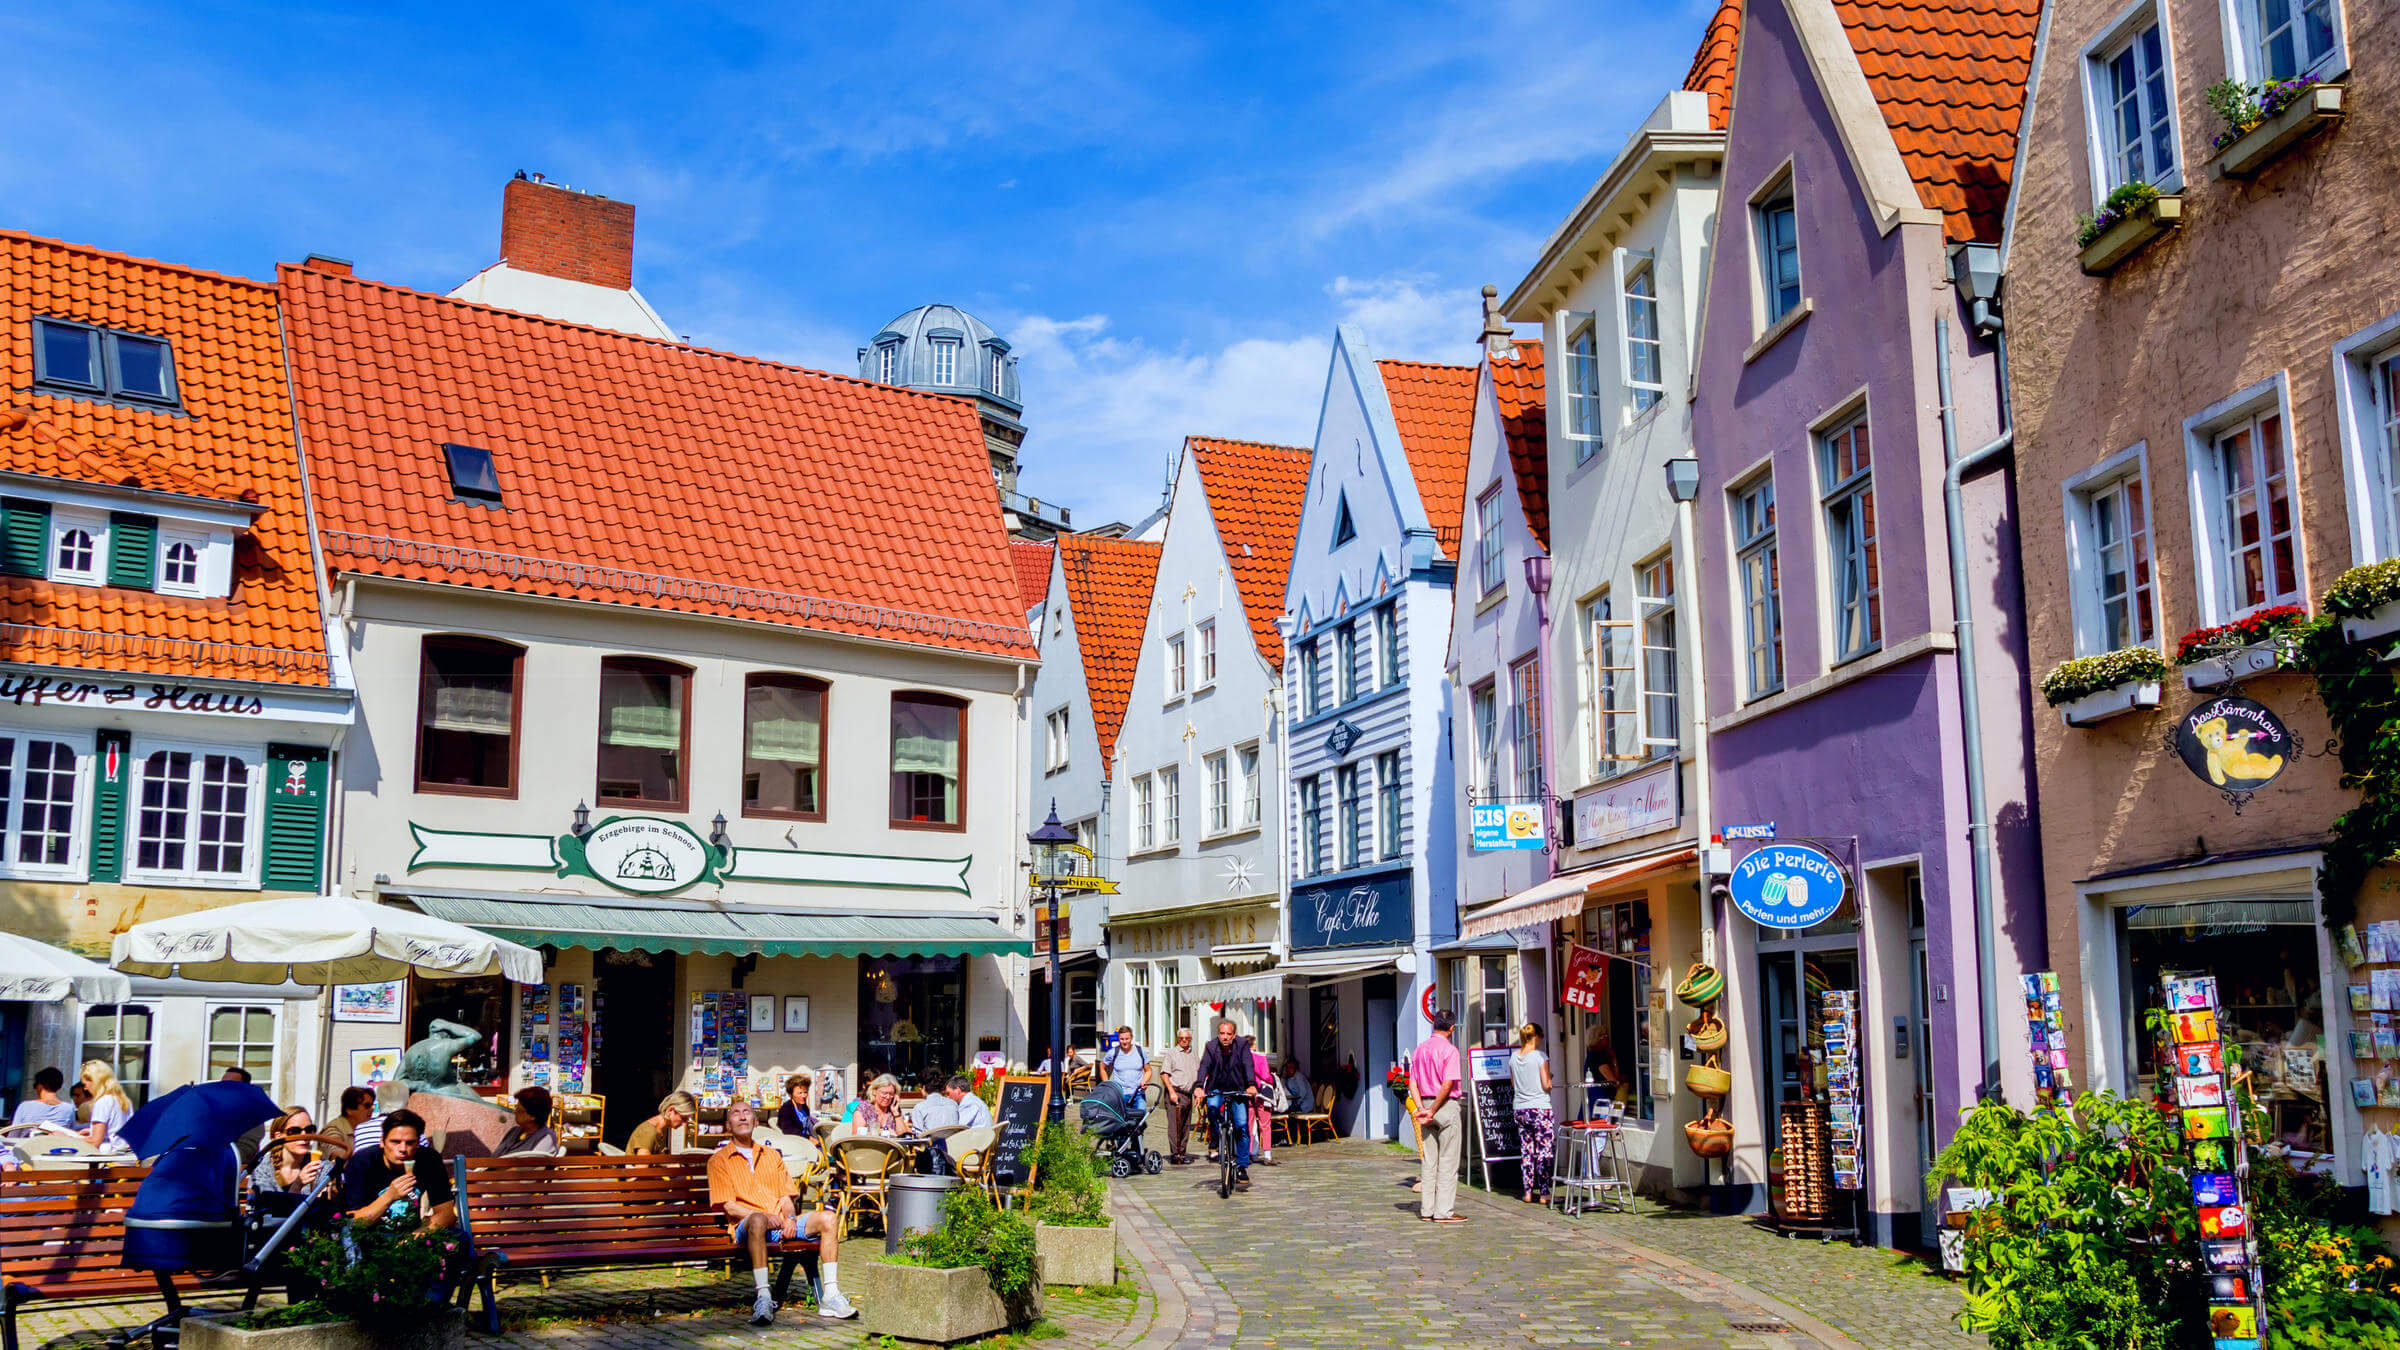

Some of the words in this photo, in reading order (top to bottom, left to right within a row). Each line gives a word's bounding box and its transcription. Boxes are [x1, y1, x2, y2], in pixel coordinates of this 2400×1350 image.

[144, 682, 263, 715] Haus
[2215, 698, 2282, 742] Bärenhaus
[1474, 809, 1504, 827] EIS
[598, 824, 645, 843] Erzgebirge
[647, 824, 660, 834] im
[662, 827, 697, 852] Schnoor
[1476, 829, 1499, 839] eigene
[1476, 839, 1516, 849] Herstellung
[1742, 857, 1771, 879] Die
[1774, 851, 1837, 884] Perlerie
[1306, 887, 1344, 946] Café
[1741, 899, 1774, 922] Perlen
[1776, 913, 1798, 924] und
[1799, 904, 1834, 921] mehr...
[1566, 987, 1596, 1008] EIS
